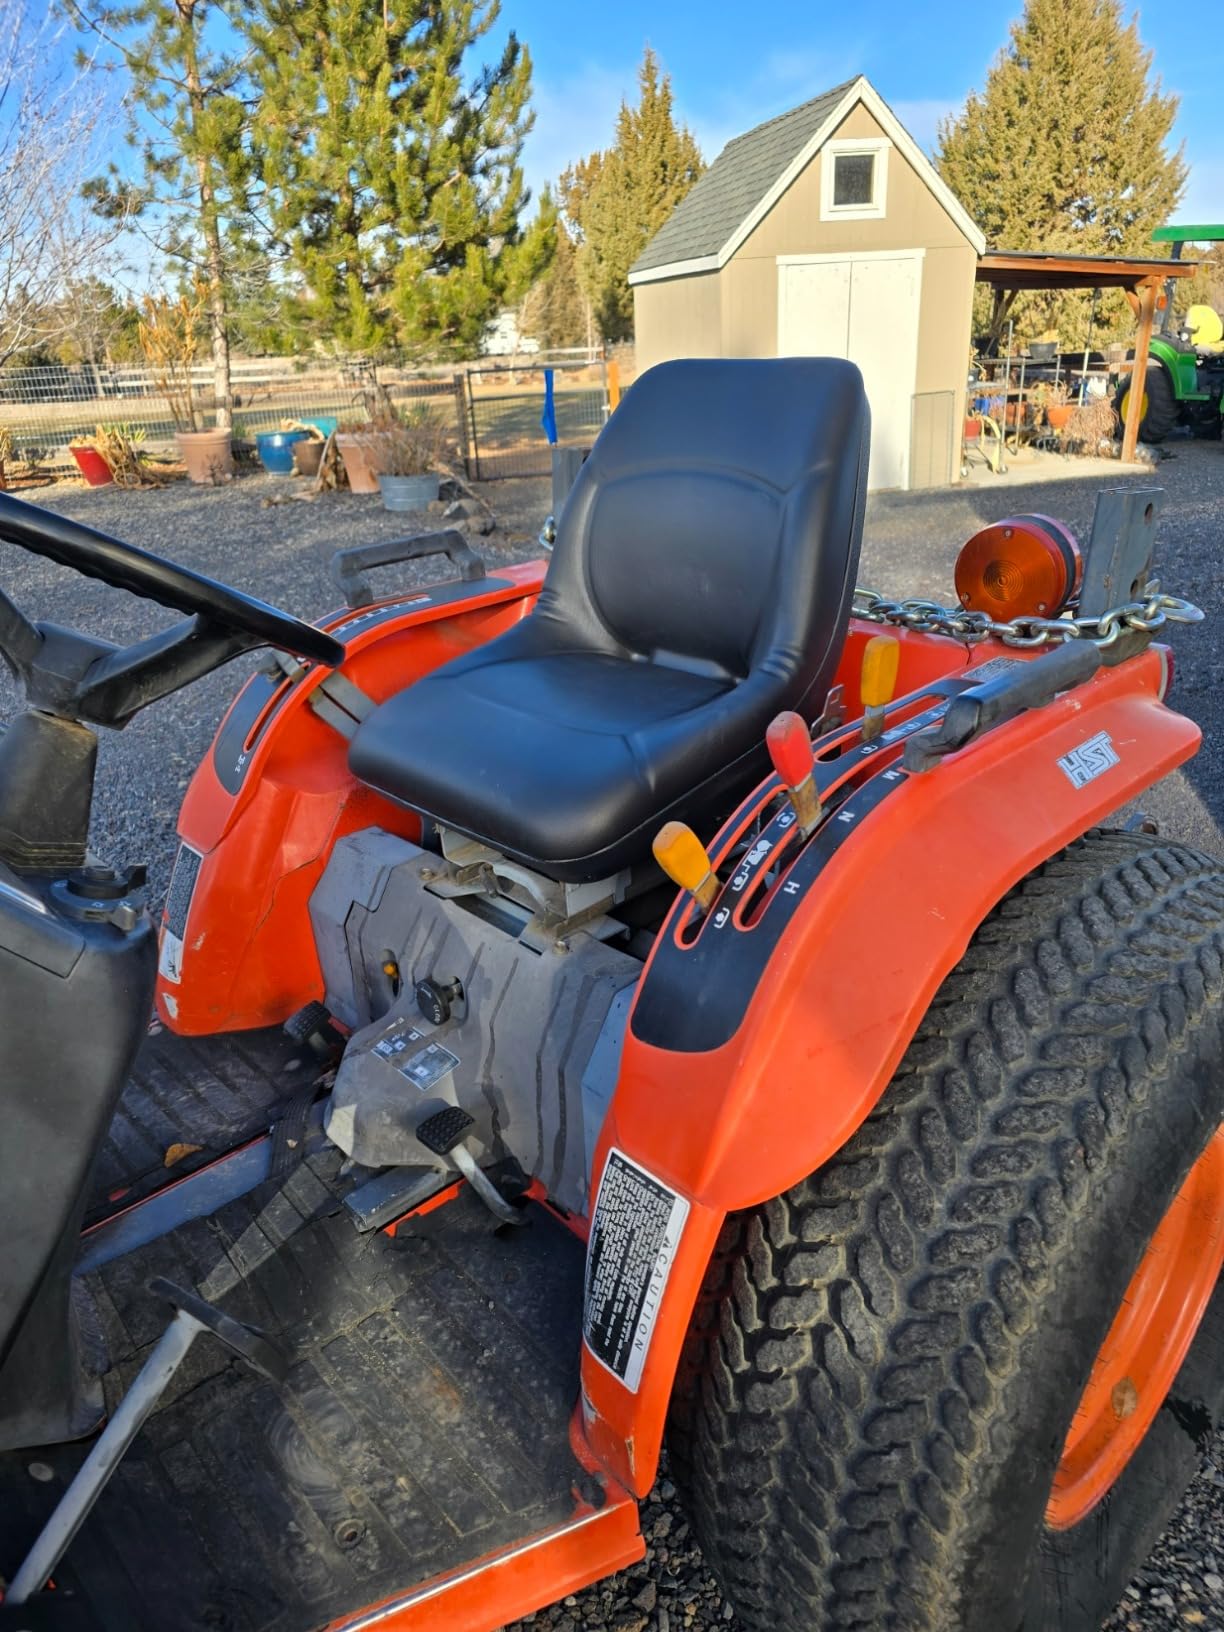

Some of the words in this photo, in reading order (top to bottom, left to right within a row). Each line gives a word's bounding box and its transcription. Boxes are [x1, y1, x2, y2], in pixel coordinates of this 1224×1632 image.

[1056, 729, 1121, 791] HST
[838, 810, 855, 823] N
[783, 880, 801, 895] H
[635, 1253, 668, 1351] CAUTION
